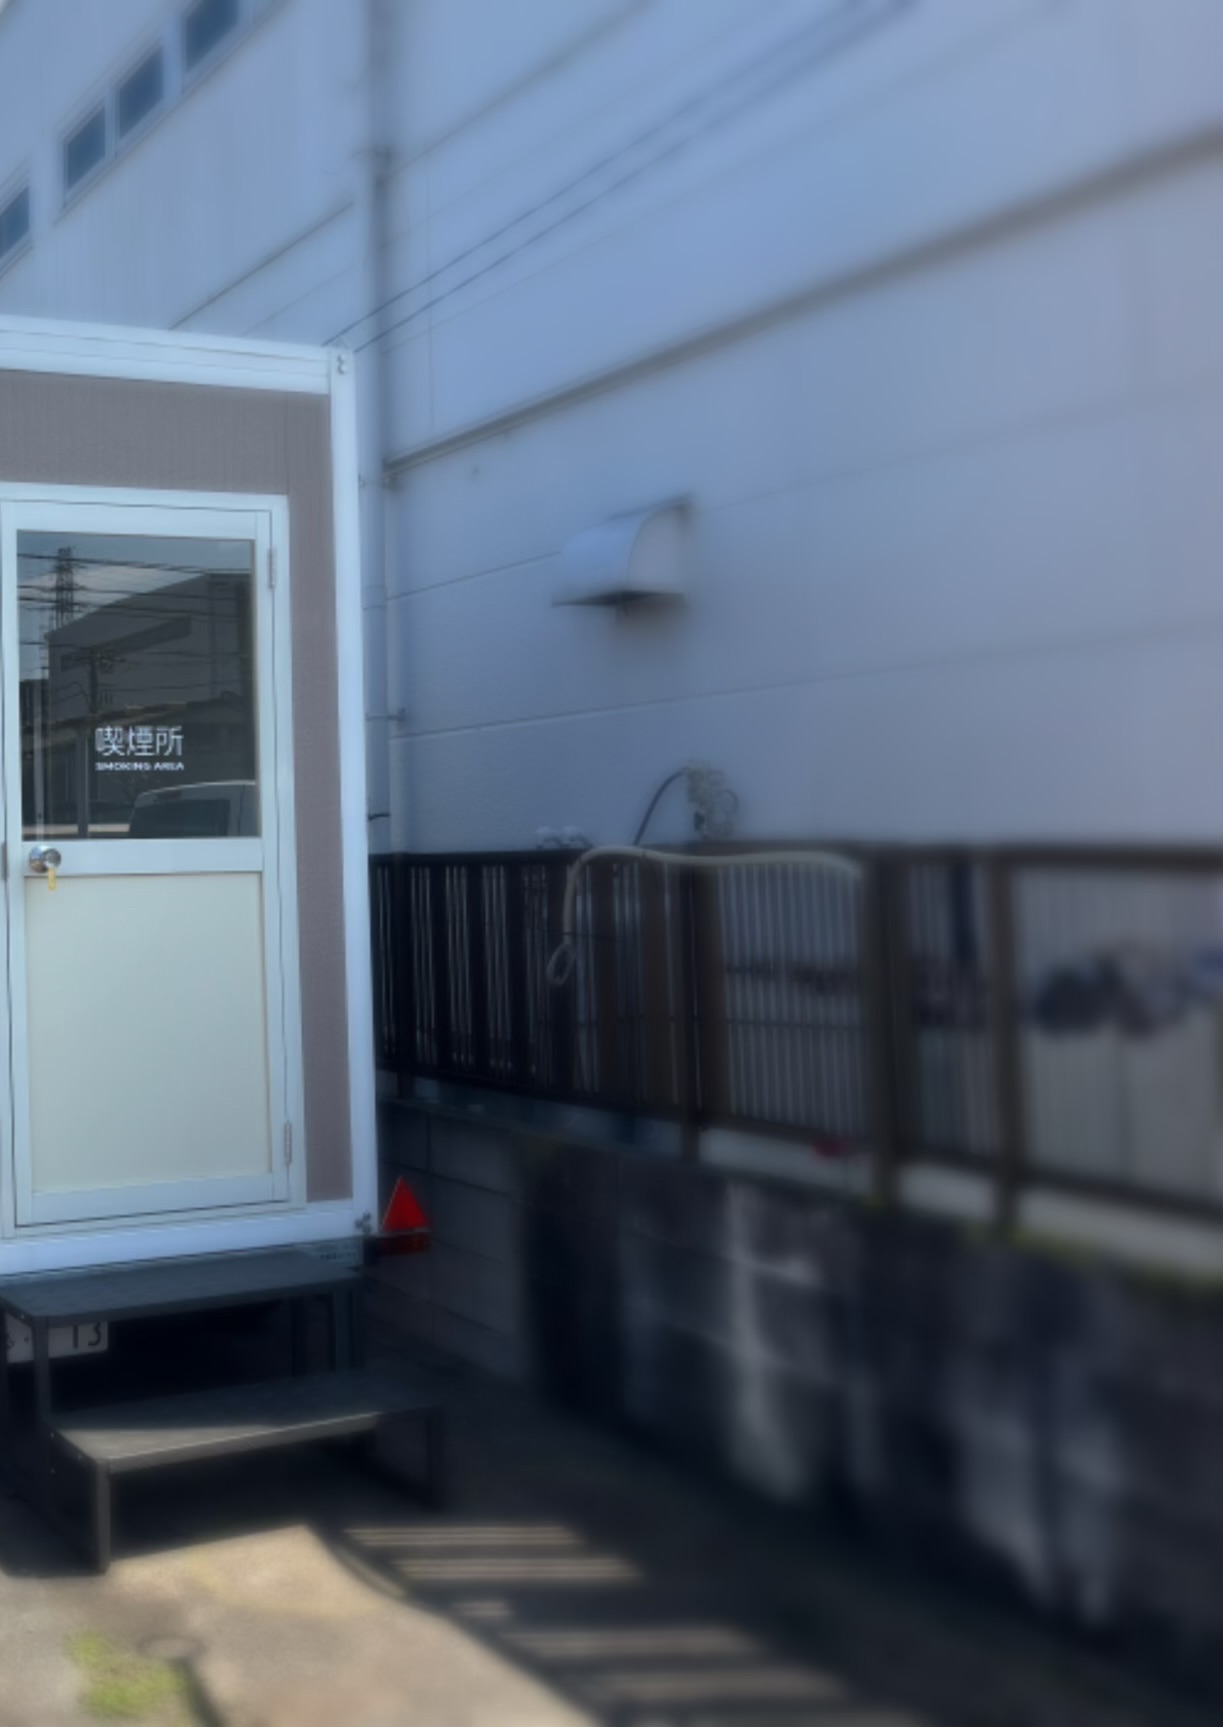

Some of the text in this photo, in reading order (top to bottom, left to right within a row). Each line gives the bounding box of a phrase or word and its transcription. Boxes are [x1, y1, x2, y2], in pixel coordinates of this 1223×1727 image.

[95, 725, 184, 756] 喫煙所
[95, 762, 184, 771] SMOKING AREA
